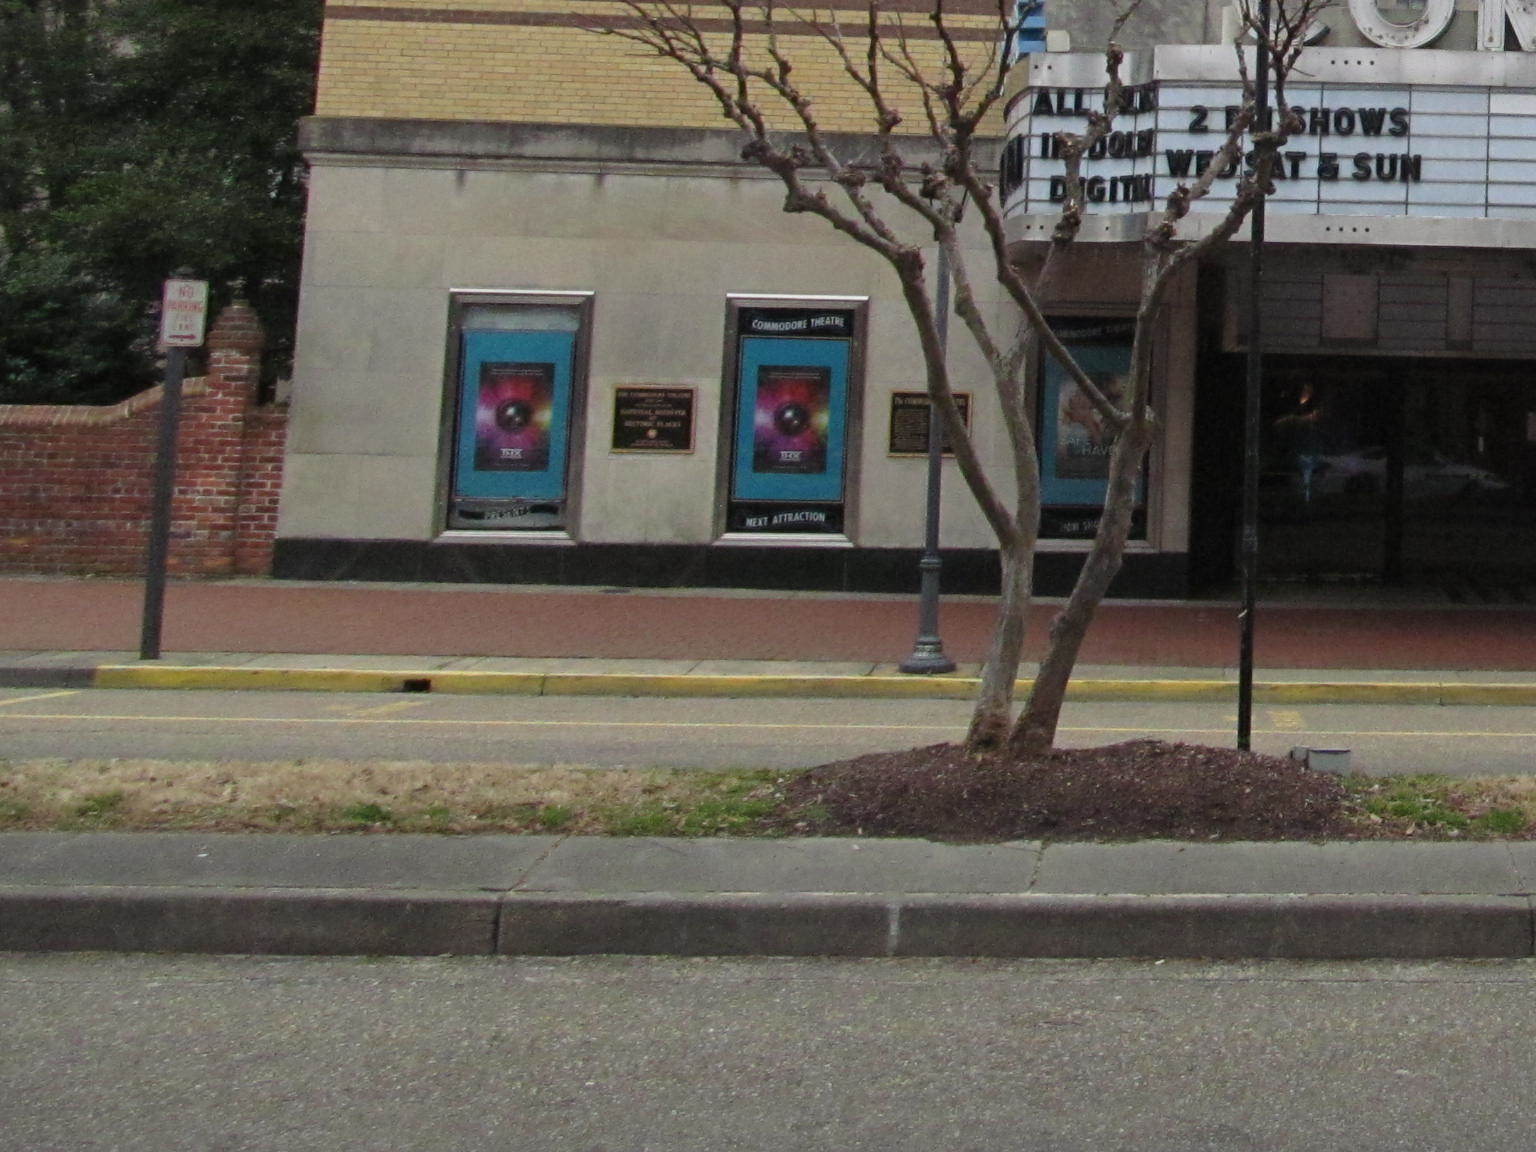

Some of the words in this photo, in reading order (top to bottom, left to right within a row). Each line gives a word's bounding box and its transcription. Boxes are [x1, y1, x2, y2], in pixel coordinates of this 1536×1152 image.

[1033, 88, 1090, 115] ALL
[1189, 105, 1207, 134] 2
[1289, 106, 1409, 137] SHOWS
[1352, 152, 1421, 182] SUN
[752, 319, 807, 331] COMMODORE
[810, 316, 845, 327] THEATRE
[746, 517, 768, 527] NEXT
[772, 512, 826, 524] ATTRACTION
